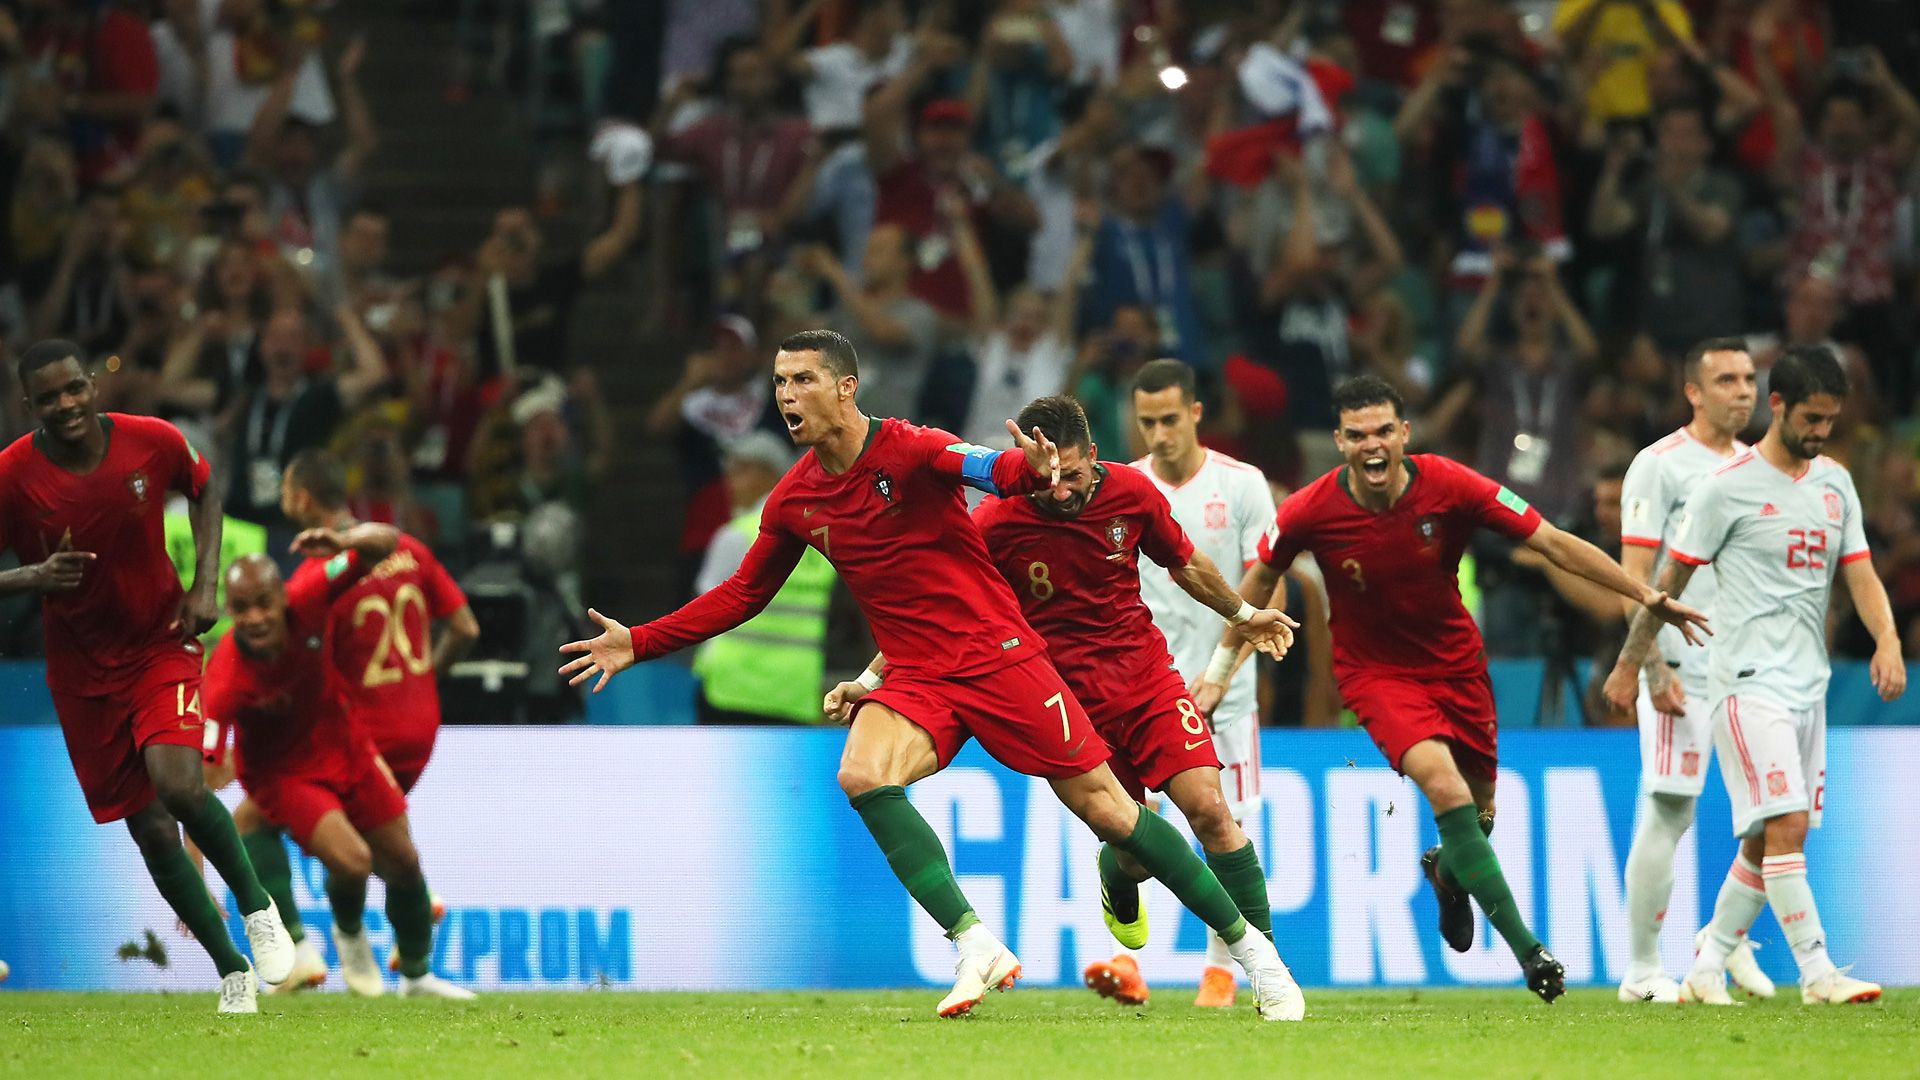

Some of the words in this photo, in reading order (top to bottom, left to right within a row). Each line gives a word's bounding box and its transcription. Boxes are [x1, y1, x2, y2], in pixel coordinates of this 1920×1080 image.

[810, 525, 830, 558] 7
[1787, 529, 1826, 568] 22
[1028, 561, 1054, 600] 8
[1342, 558, 1366, 592] 3
[353, 583, 431, 687] 20
[177, 682, 203, 721] 14
[1043, 691, 1071, 742] 7
[1175, 698, 1204, 735] 8
[361, 907, 634, 983] ZPROM
